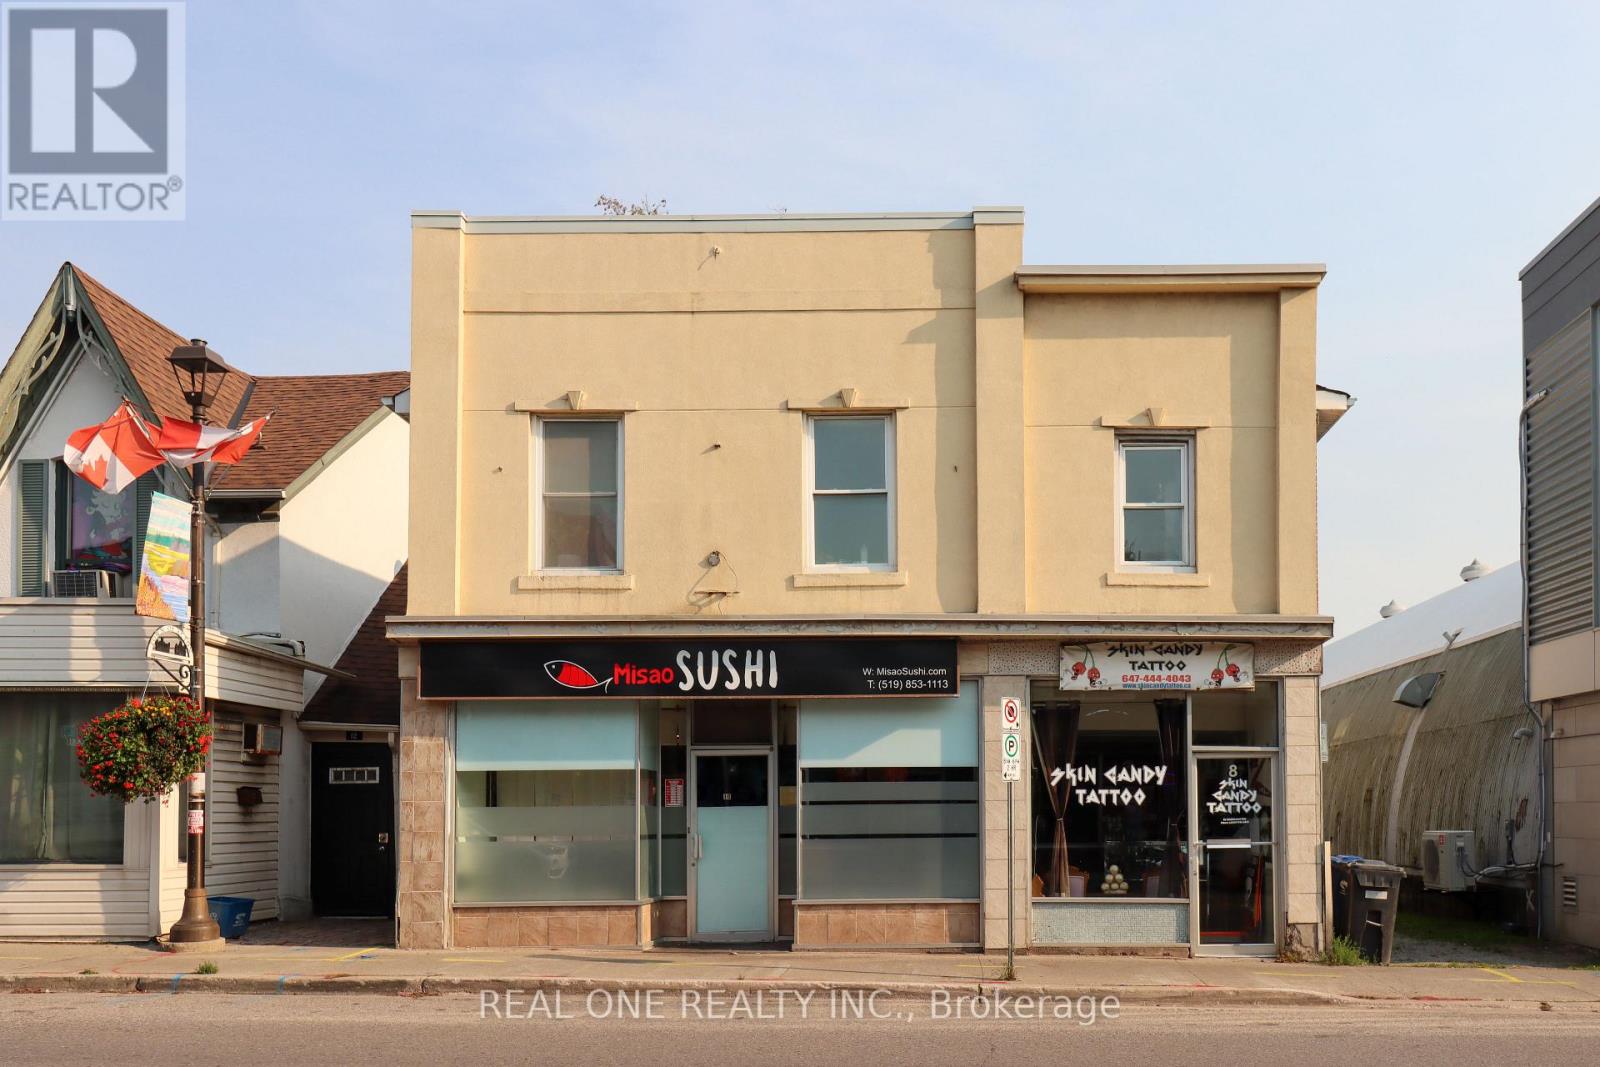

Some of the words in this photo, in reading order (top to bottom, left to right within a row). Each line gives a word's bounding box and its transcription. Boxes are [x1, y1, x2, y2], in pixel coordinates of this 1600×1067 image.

[1152, 643, 1203, 656] CANDY
[613, 663, 675, 686] Misao
[676, 649, 779, 692] SUSHI
[862, 667, 875, 676] W:
[876, 667, 947, 676] MisaoSushi.com
[1128, 660, 1186, 671] TATTOO
[1122, 674, 1191, 683] 647-444-4043
[867, 680, 875, 689] T:
[878, 680, 903, 690] (519)
[905, 680, 949, 689] 853-1113
[1008, 740, 1015, 751] P
[1050, 763, 1097, 787] SKIN
[1103, 764, 1168, 786] CANDY
[1229, 764, 1238, 777] 8
[1075, 787, 1147, 806] TATTOO
[1212, 790, 1257, 802] CANDY
[1206, 802, 1262, 814] TATTOO
